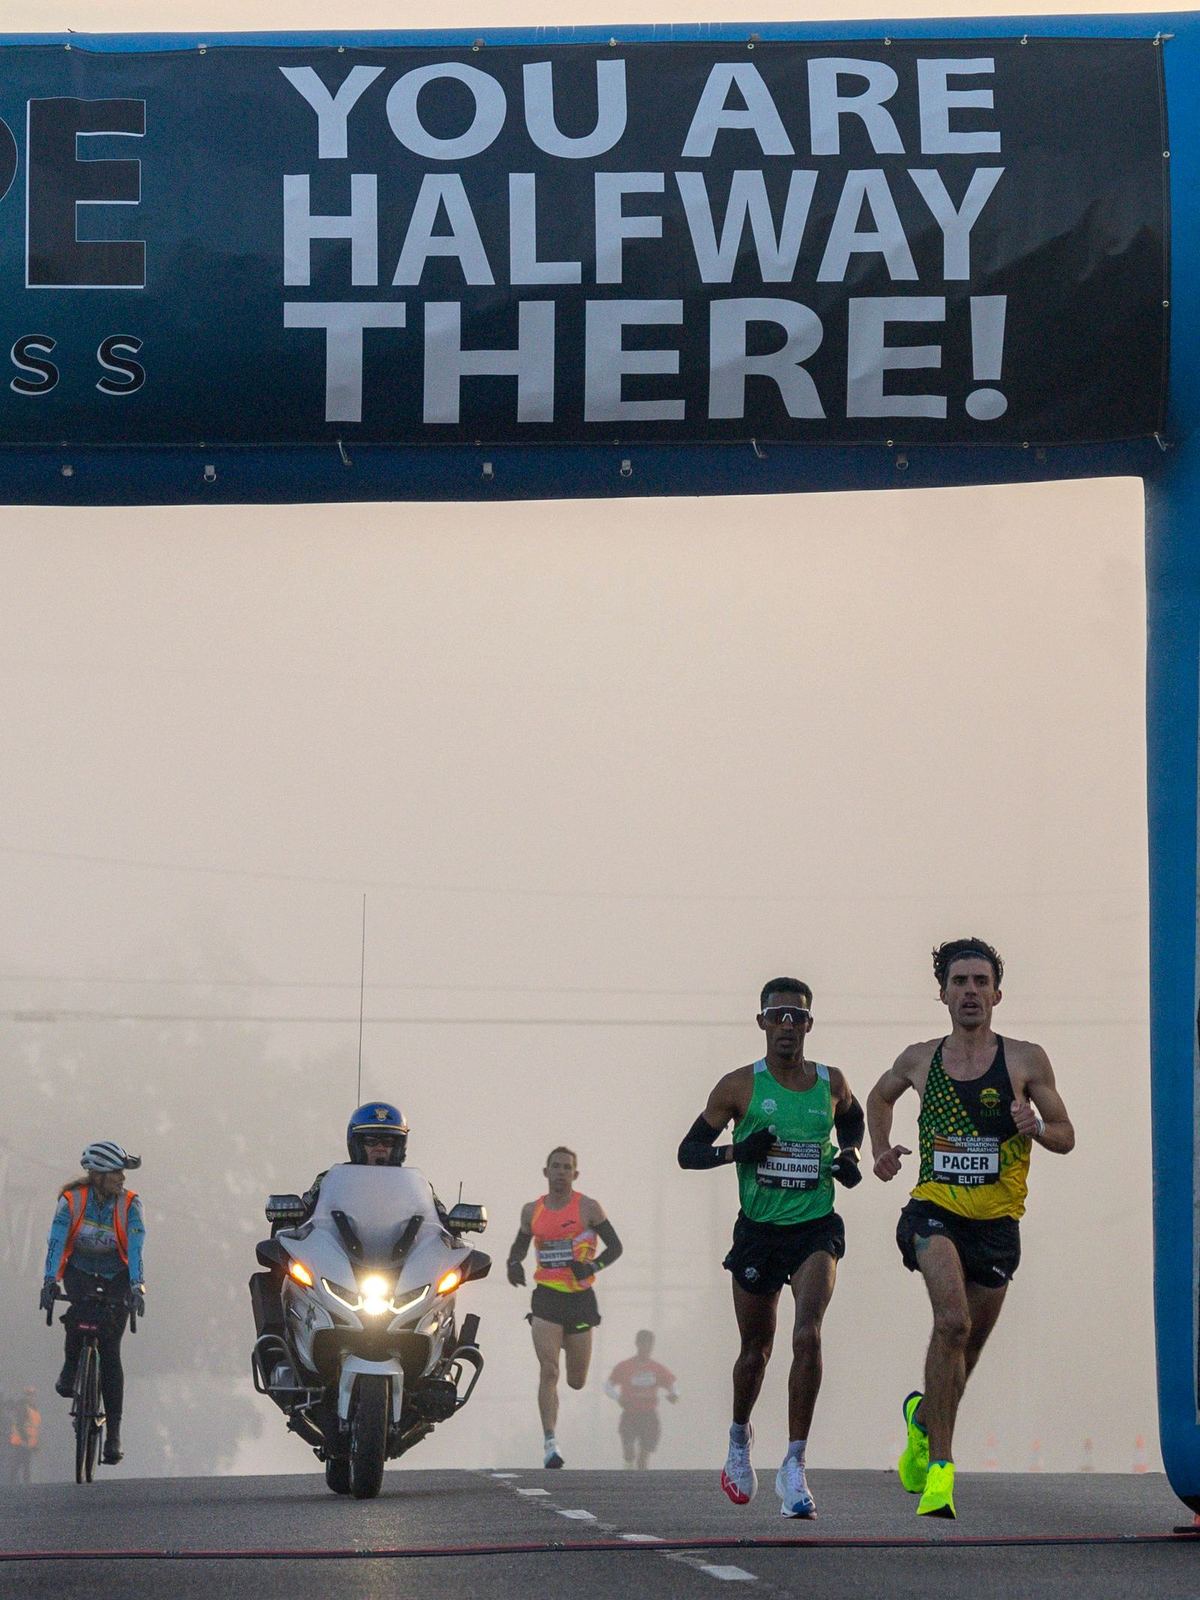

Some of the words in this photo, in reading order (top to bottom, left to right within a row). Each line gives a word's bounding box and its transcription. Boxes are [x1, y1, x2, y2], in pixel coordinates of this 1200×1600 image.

[279, 58, 627, 160] YOU
[681, 57, 1001, 157] ARE
[0, 97, 146, 289] E
[283, 167, 1005, 286] HALFWAY
[283, 295, 1008, 424] THERE!
[781, 1178, 806, 1189] ELITE
[942, 1155, 989, 1170] PACER
[958, 1175, 985, 1184] ELITE
